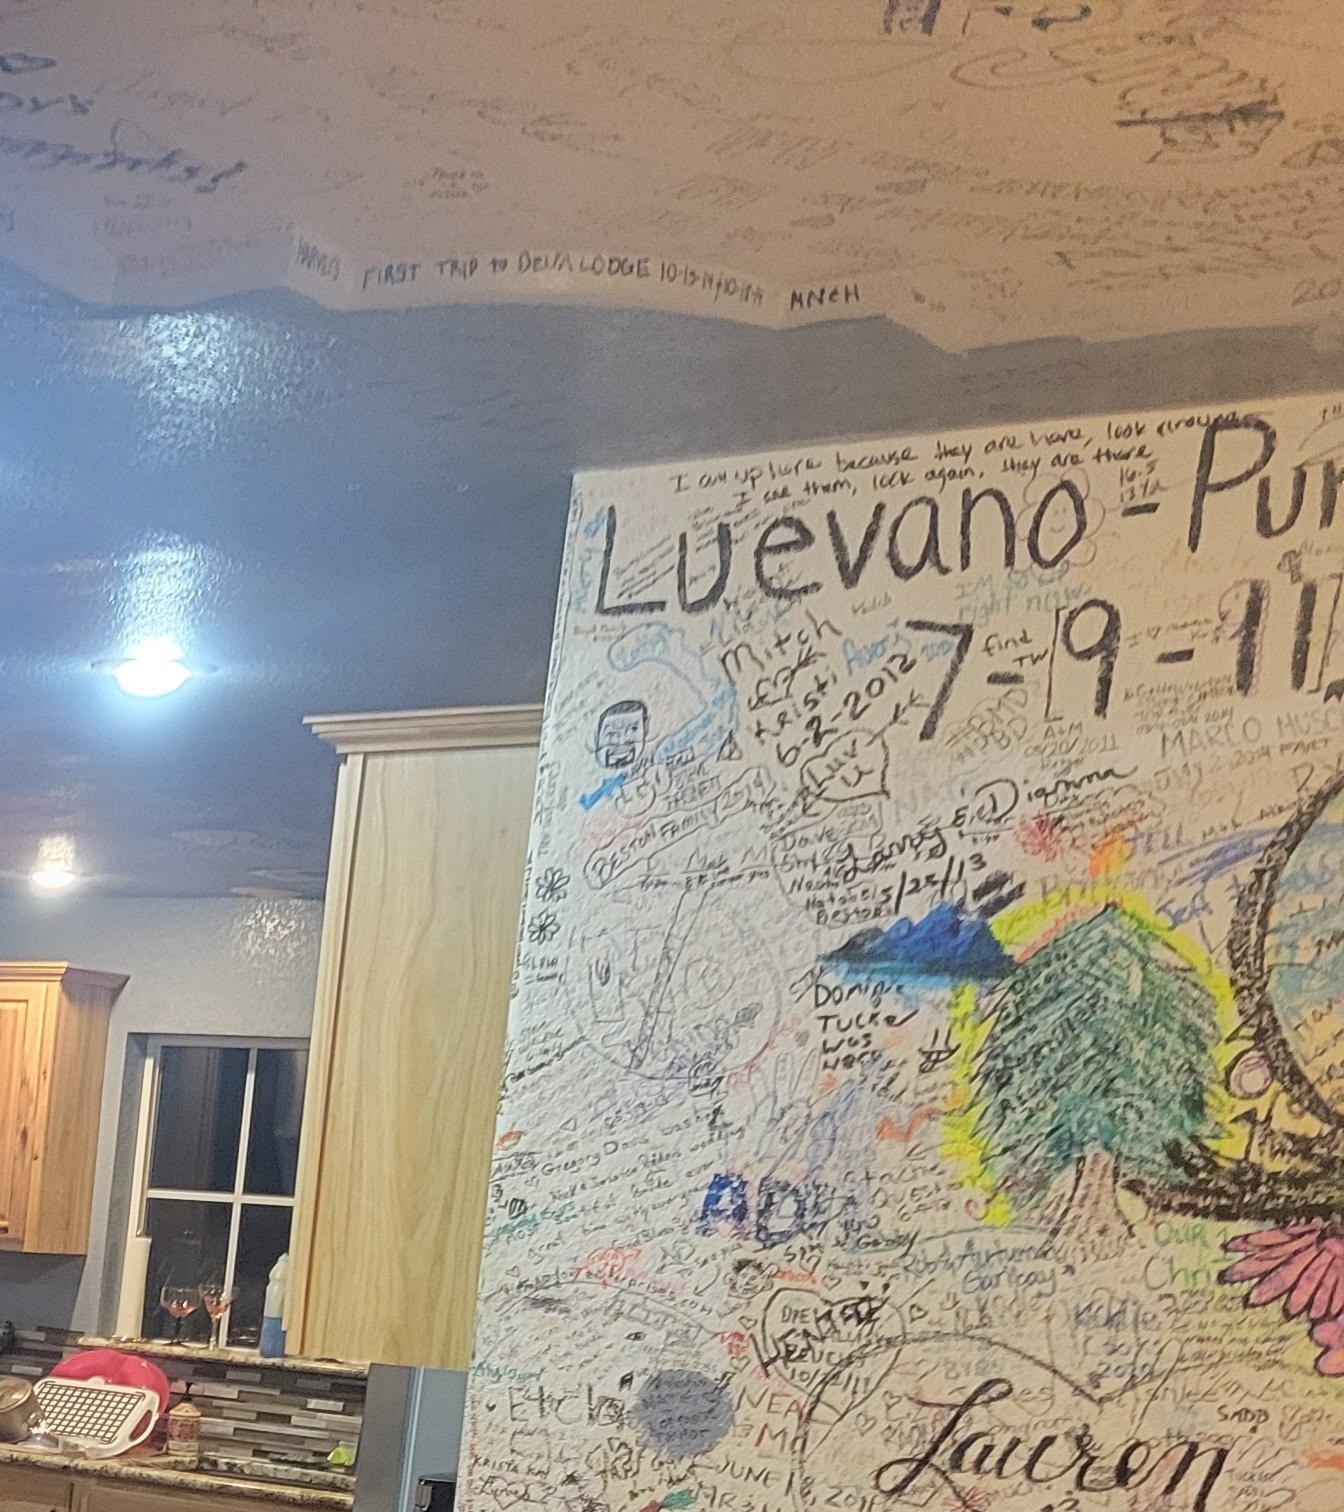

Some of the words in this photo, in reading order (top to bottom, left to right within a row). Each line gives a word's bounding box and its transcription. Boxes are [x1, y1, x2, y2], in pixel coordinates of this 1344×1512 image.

[835, 446, 919, 474] because
[934, 438, 974, 467] they
[1106, 419, 1147, 443] look
